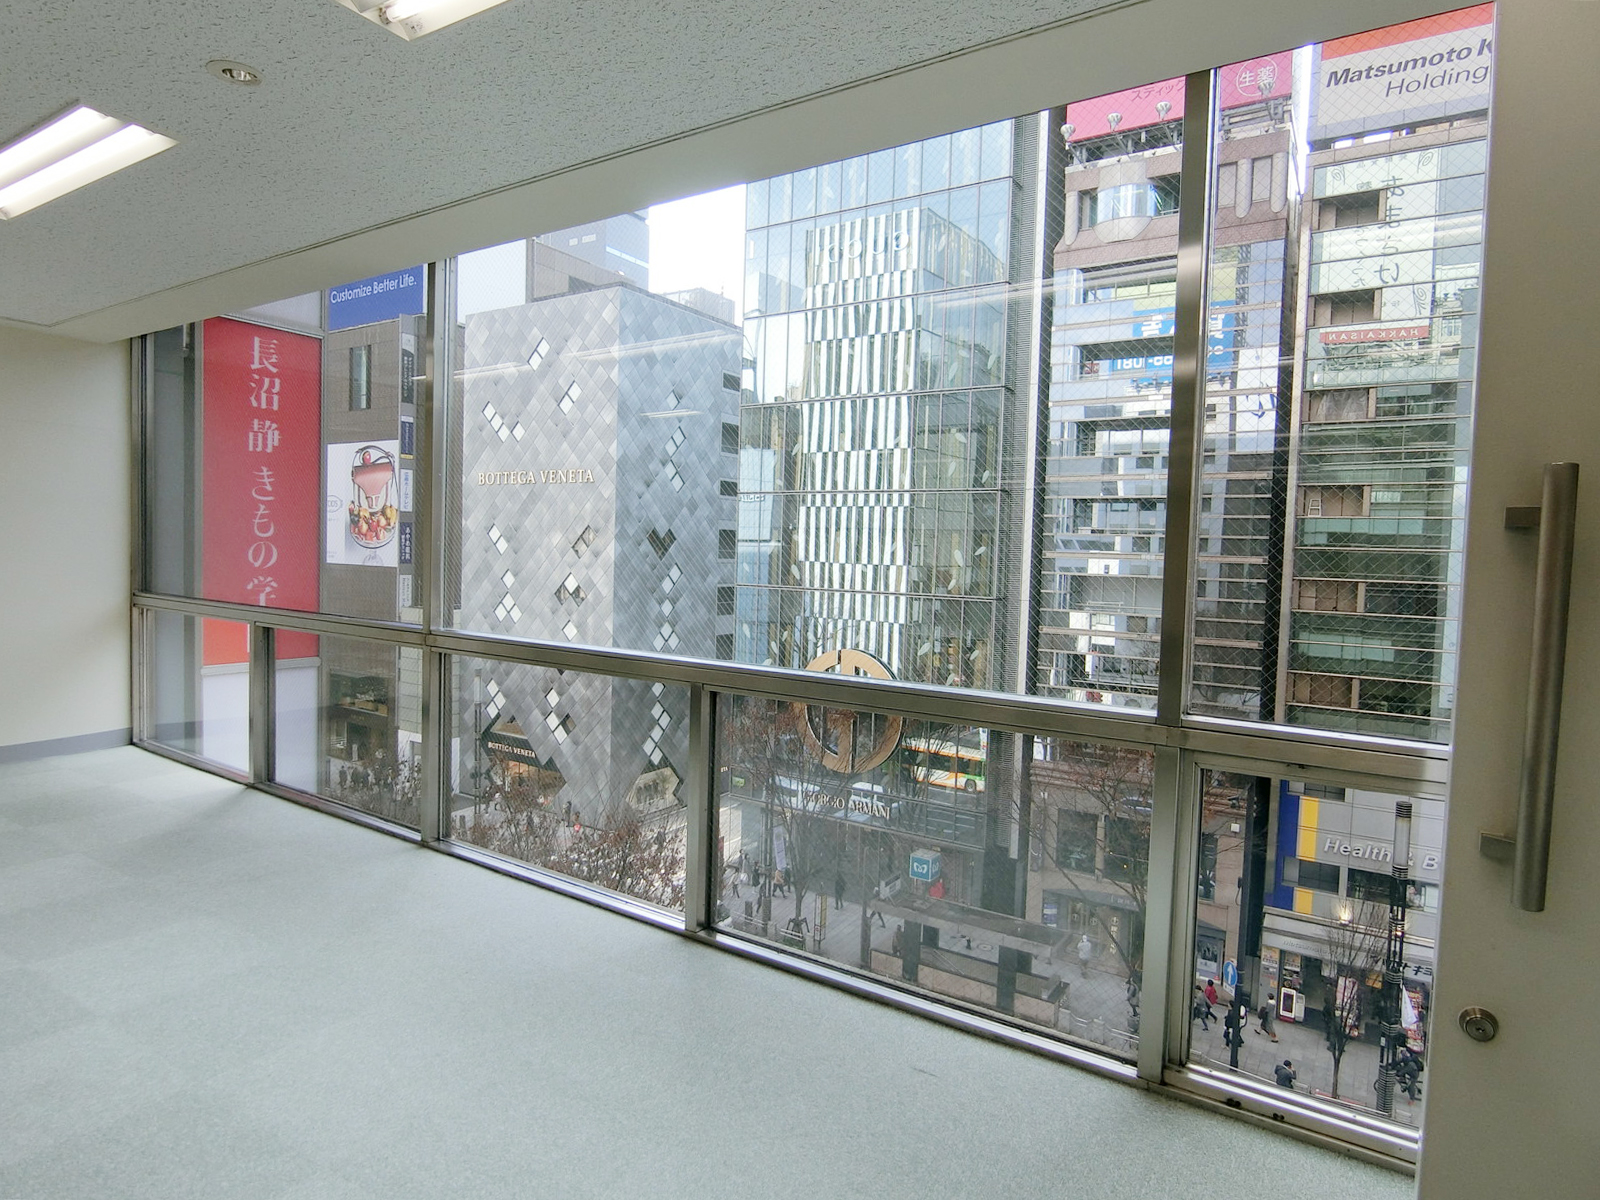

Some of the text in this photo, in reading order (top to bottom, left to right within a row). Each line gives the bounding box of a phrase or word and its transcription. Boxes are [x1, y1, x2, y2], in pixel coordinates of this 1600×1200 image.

[1326, 45, 1472, 88] Matsumoto
[1385, 65, 1489, 98] Holding
[330, 273, 417, 304] Customize Better Life.
[478, 469, 595, 486] BOTTEGA VENETA
[487, 741, 536, 758] BOTTEGA VENETA
[848, 799, 890, 821] ARMANI
[1323, 837, 1392, 863] Health
